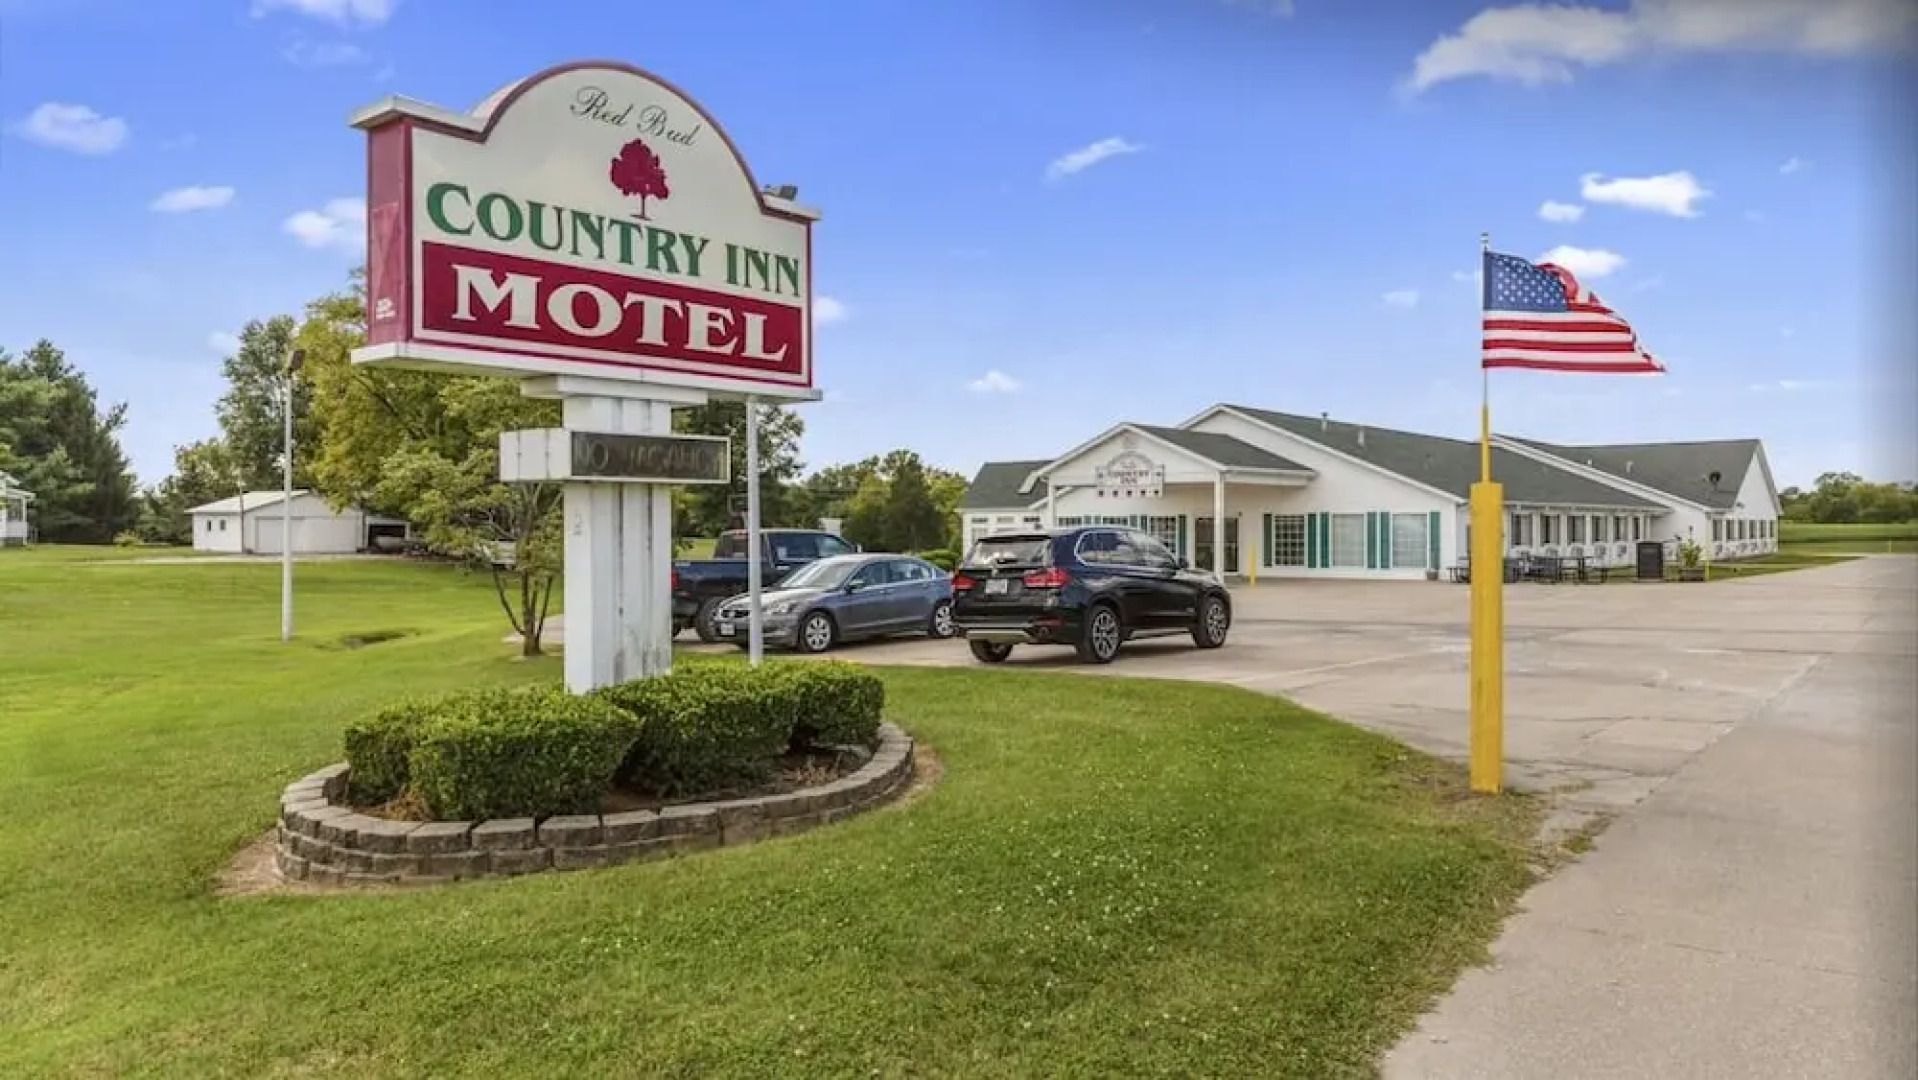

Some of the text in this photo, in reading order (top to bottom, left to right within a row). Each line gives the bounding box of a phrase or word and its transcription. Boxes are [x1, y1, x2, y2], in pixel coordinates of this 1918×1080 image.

[569, 86, 701, 146] Red Bud
[426, 182, 800, 297] COUNTRY INN
[451, 264, 788, 362] MOTEL
